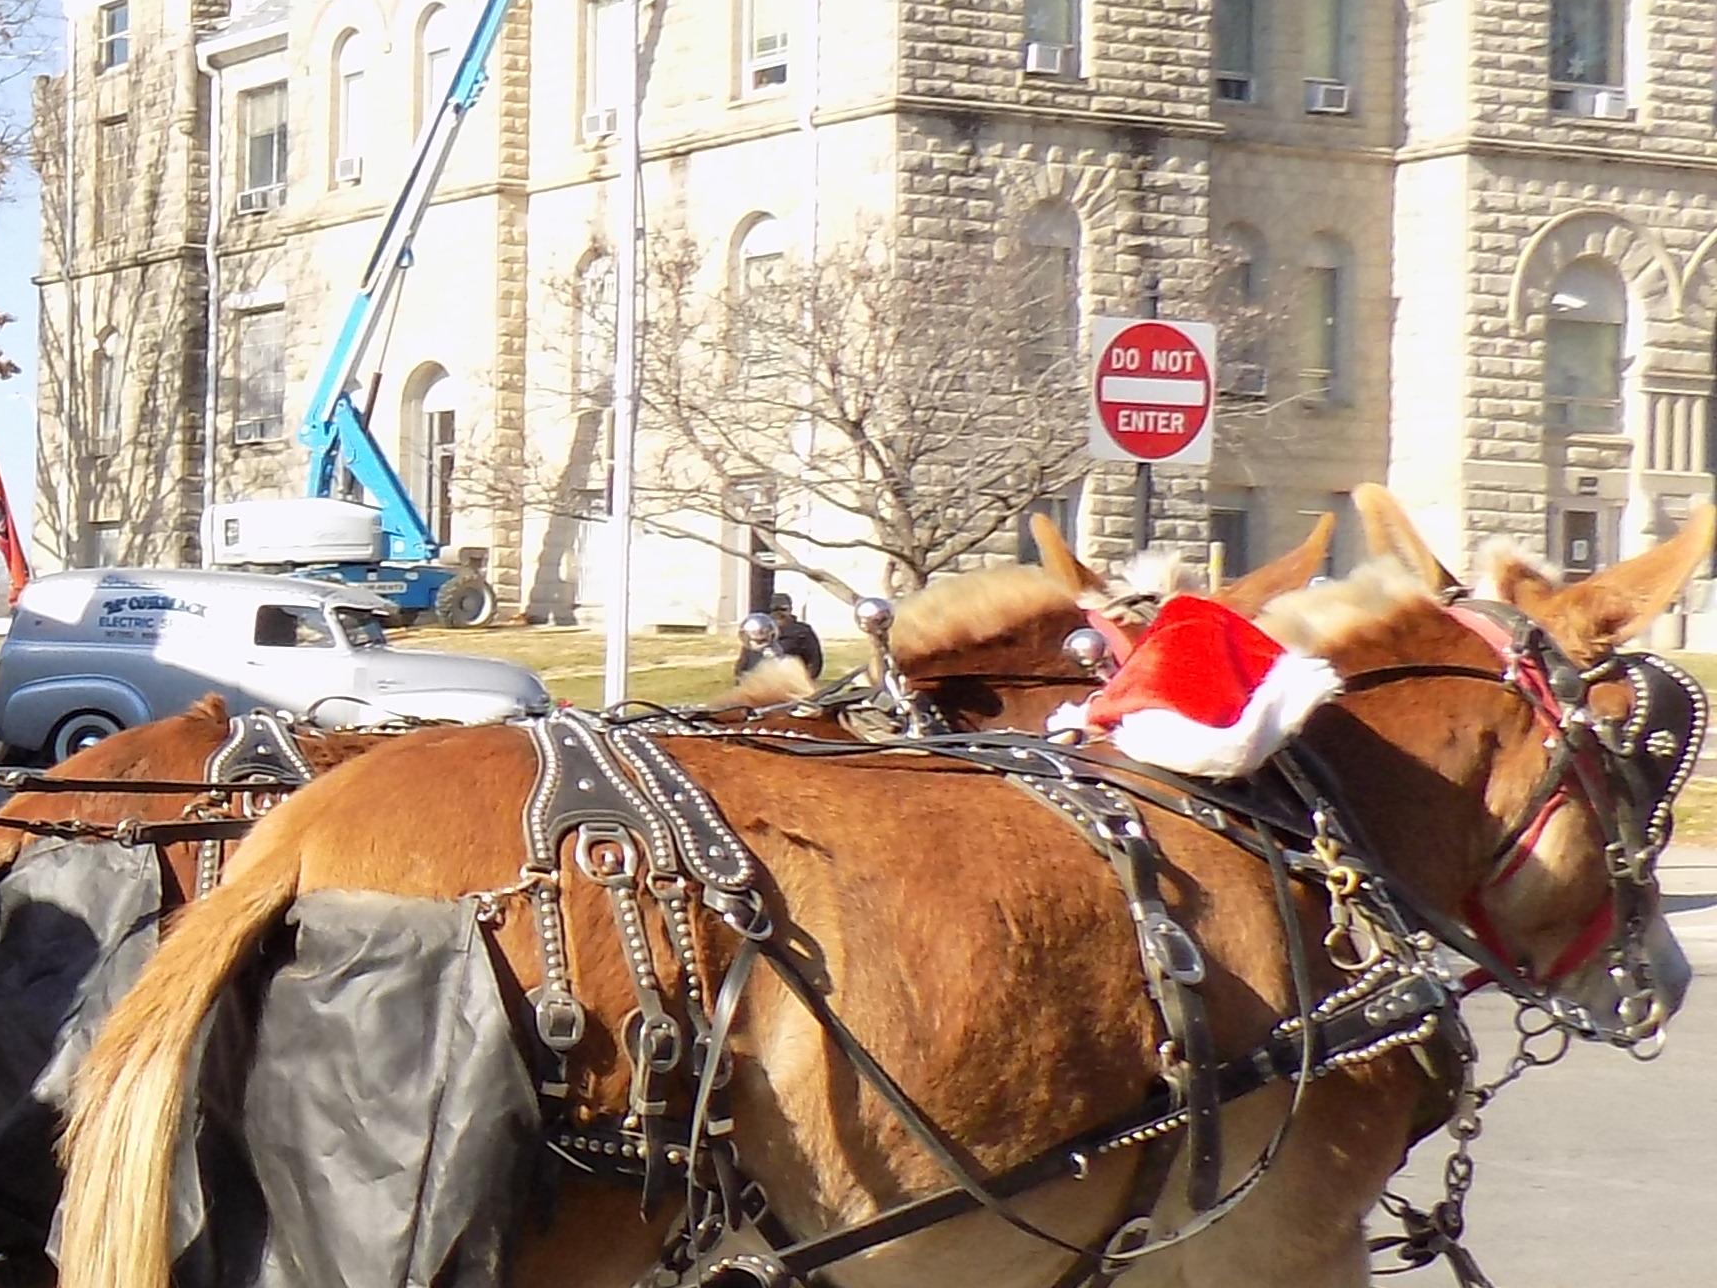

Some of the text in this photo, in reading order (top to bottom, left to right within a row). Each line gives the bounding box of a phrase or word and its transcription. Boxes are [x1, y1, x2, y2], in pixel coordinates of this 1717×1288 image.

[1111, 348, 1196, 373] DO NOT
[1118, 411, 1185, 433] ENTER
[99, 616, 155, 629] ELECTRIC
